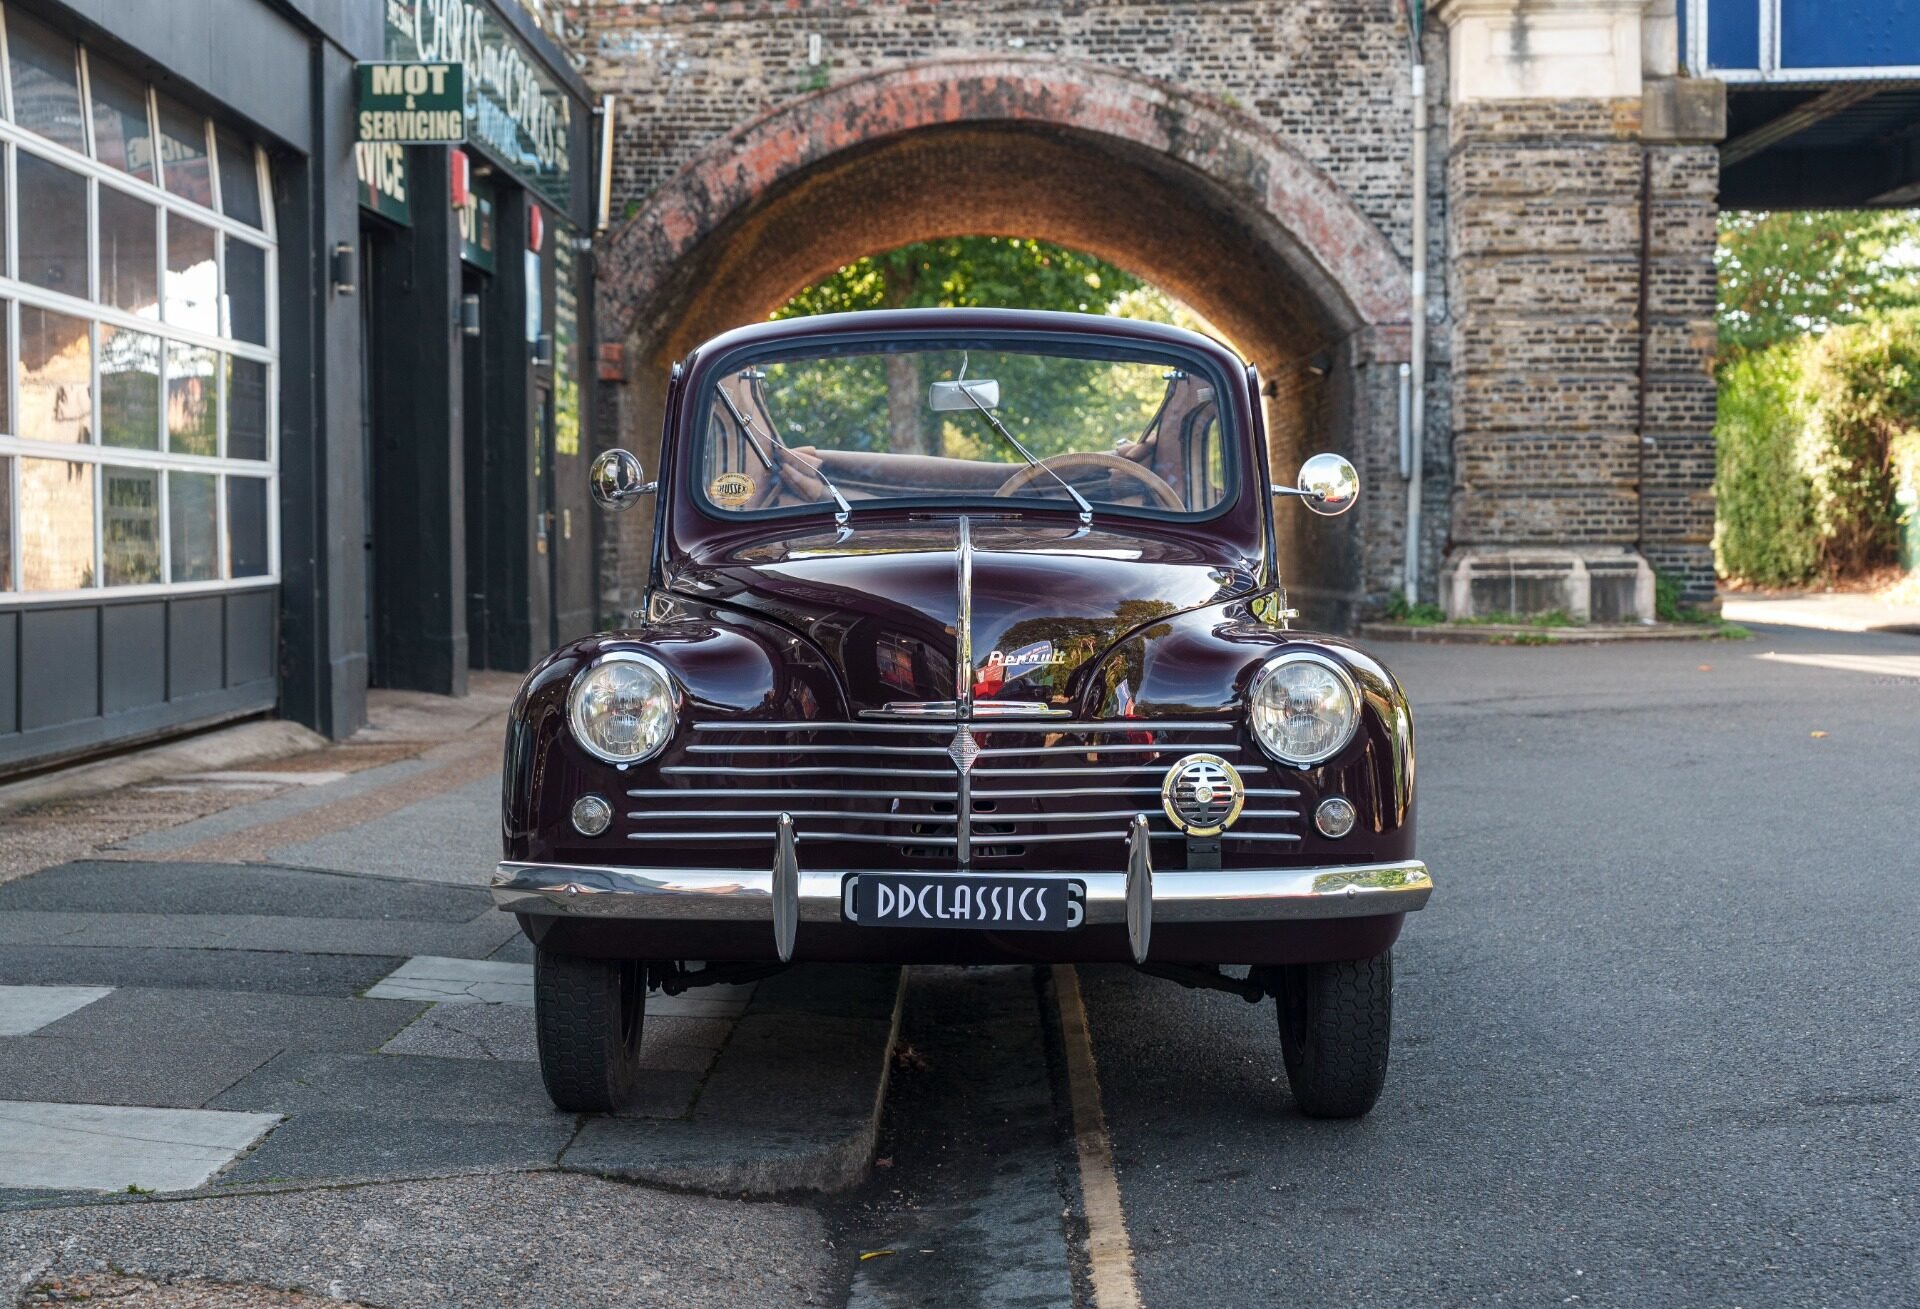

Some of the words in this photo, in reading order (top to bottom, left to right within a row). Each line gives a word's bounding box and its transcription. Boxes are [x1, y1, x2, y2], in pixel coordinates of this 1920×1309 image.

[372, 65, 449, 95] MOT
[405, 95, 416, 110] &
[360, 110, 462, 140] SERVICING
[988, 648, 1066, 667] Renault
